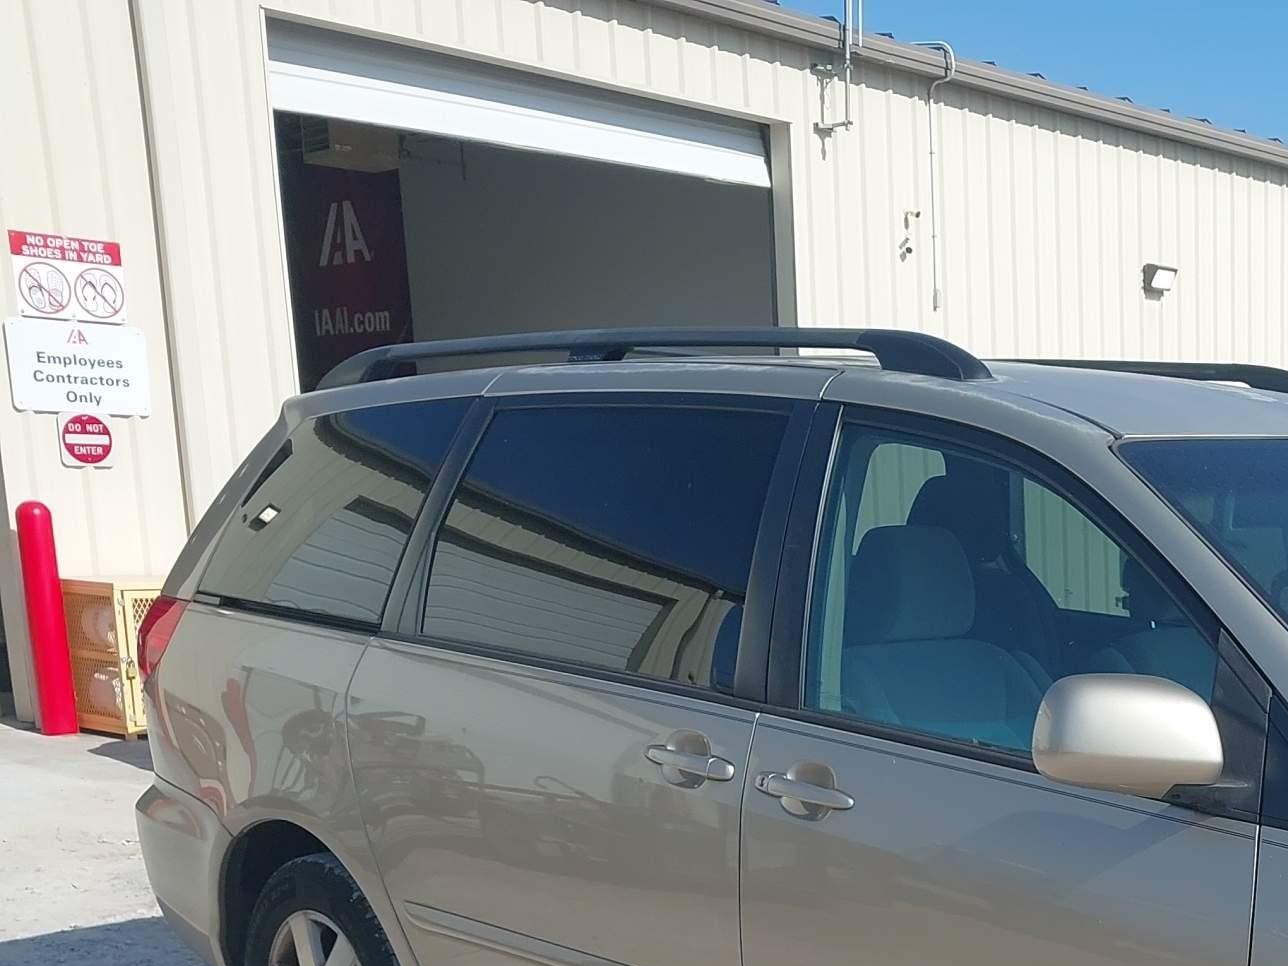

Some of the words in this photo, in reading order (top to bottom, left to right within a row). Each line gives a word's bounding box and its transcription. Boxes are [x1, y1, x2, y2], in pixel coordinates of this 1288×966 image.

[26, 235, 44, 246] NO
[46, 238, 79, 250] OPEN
[81, 242, 105, 253] TOE
[21, 245, 62, 258] SHOES
[65, 251, 78, 260] IN
[80, 252, 112, 264] YARD
[314, 306, 391, 336] IAAI.com
[36, 351, 124, 370] Employees
[33, 370, 131, 388] Contractors
[66, 391, 102, 406] Only
[67, 423, 82, 433] DO
[86, 424, 104, 433] NOT
[74, 446, 104, 456] ENTER
